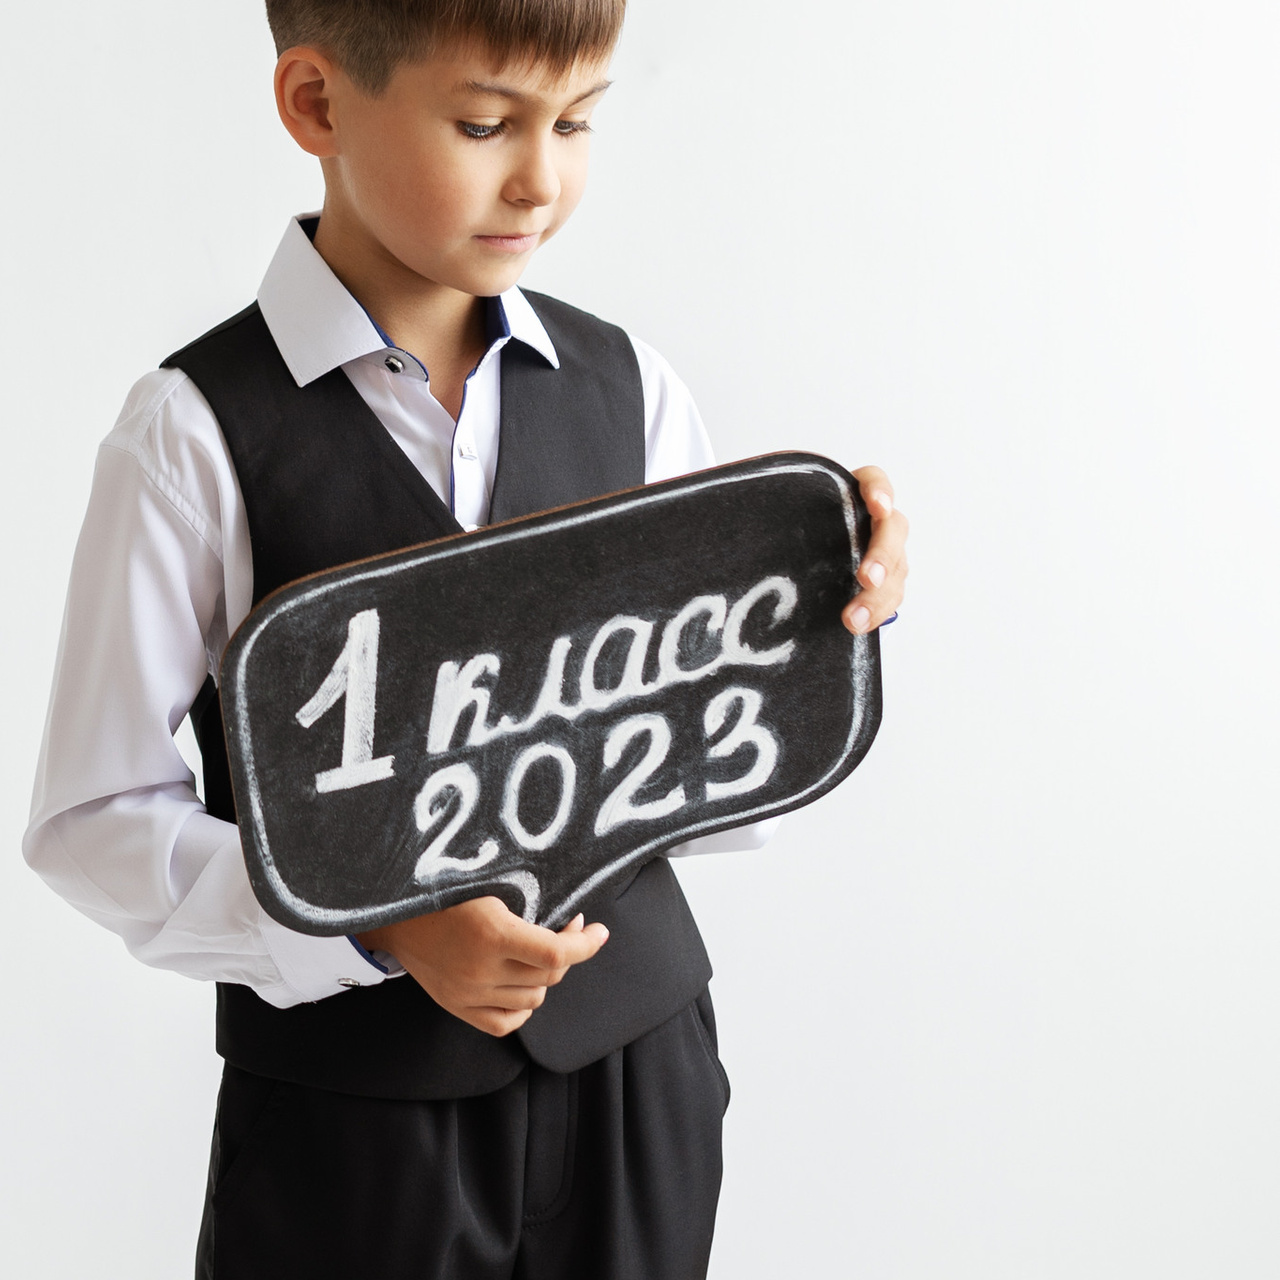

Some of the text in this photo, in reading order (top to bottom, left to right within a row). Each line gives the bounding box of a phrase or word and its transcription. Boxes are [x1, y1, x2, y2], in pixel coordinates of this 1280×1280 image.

[295, 575, 797, 793] 1 класс
[414, 686, 779, 885] 2023
